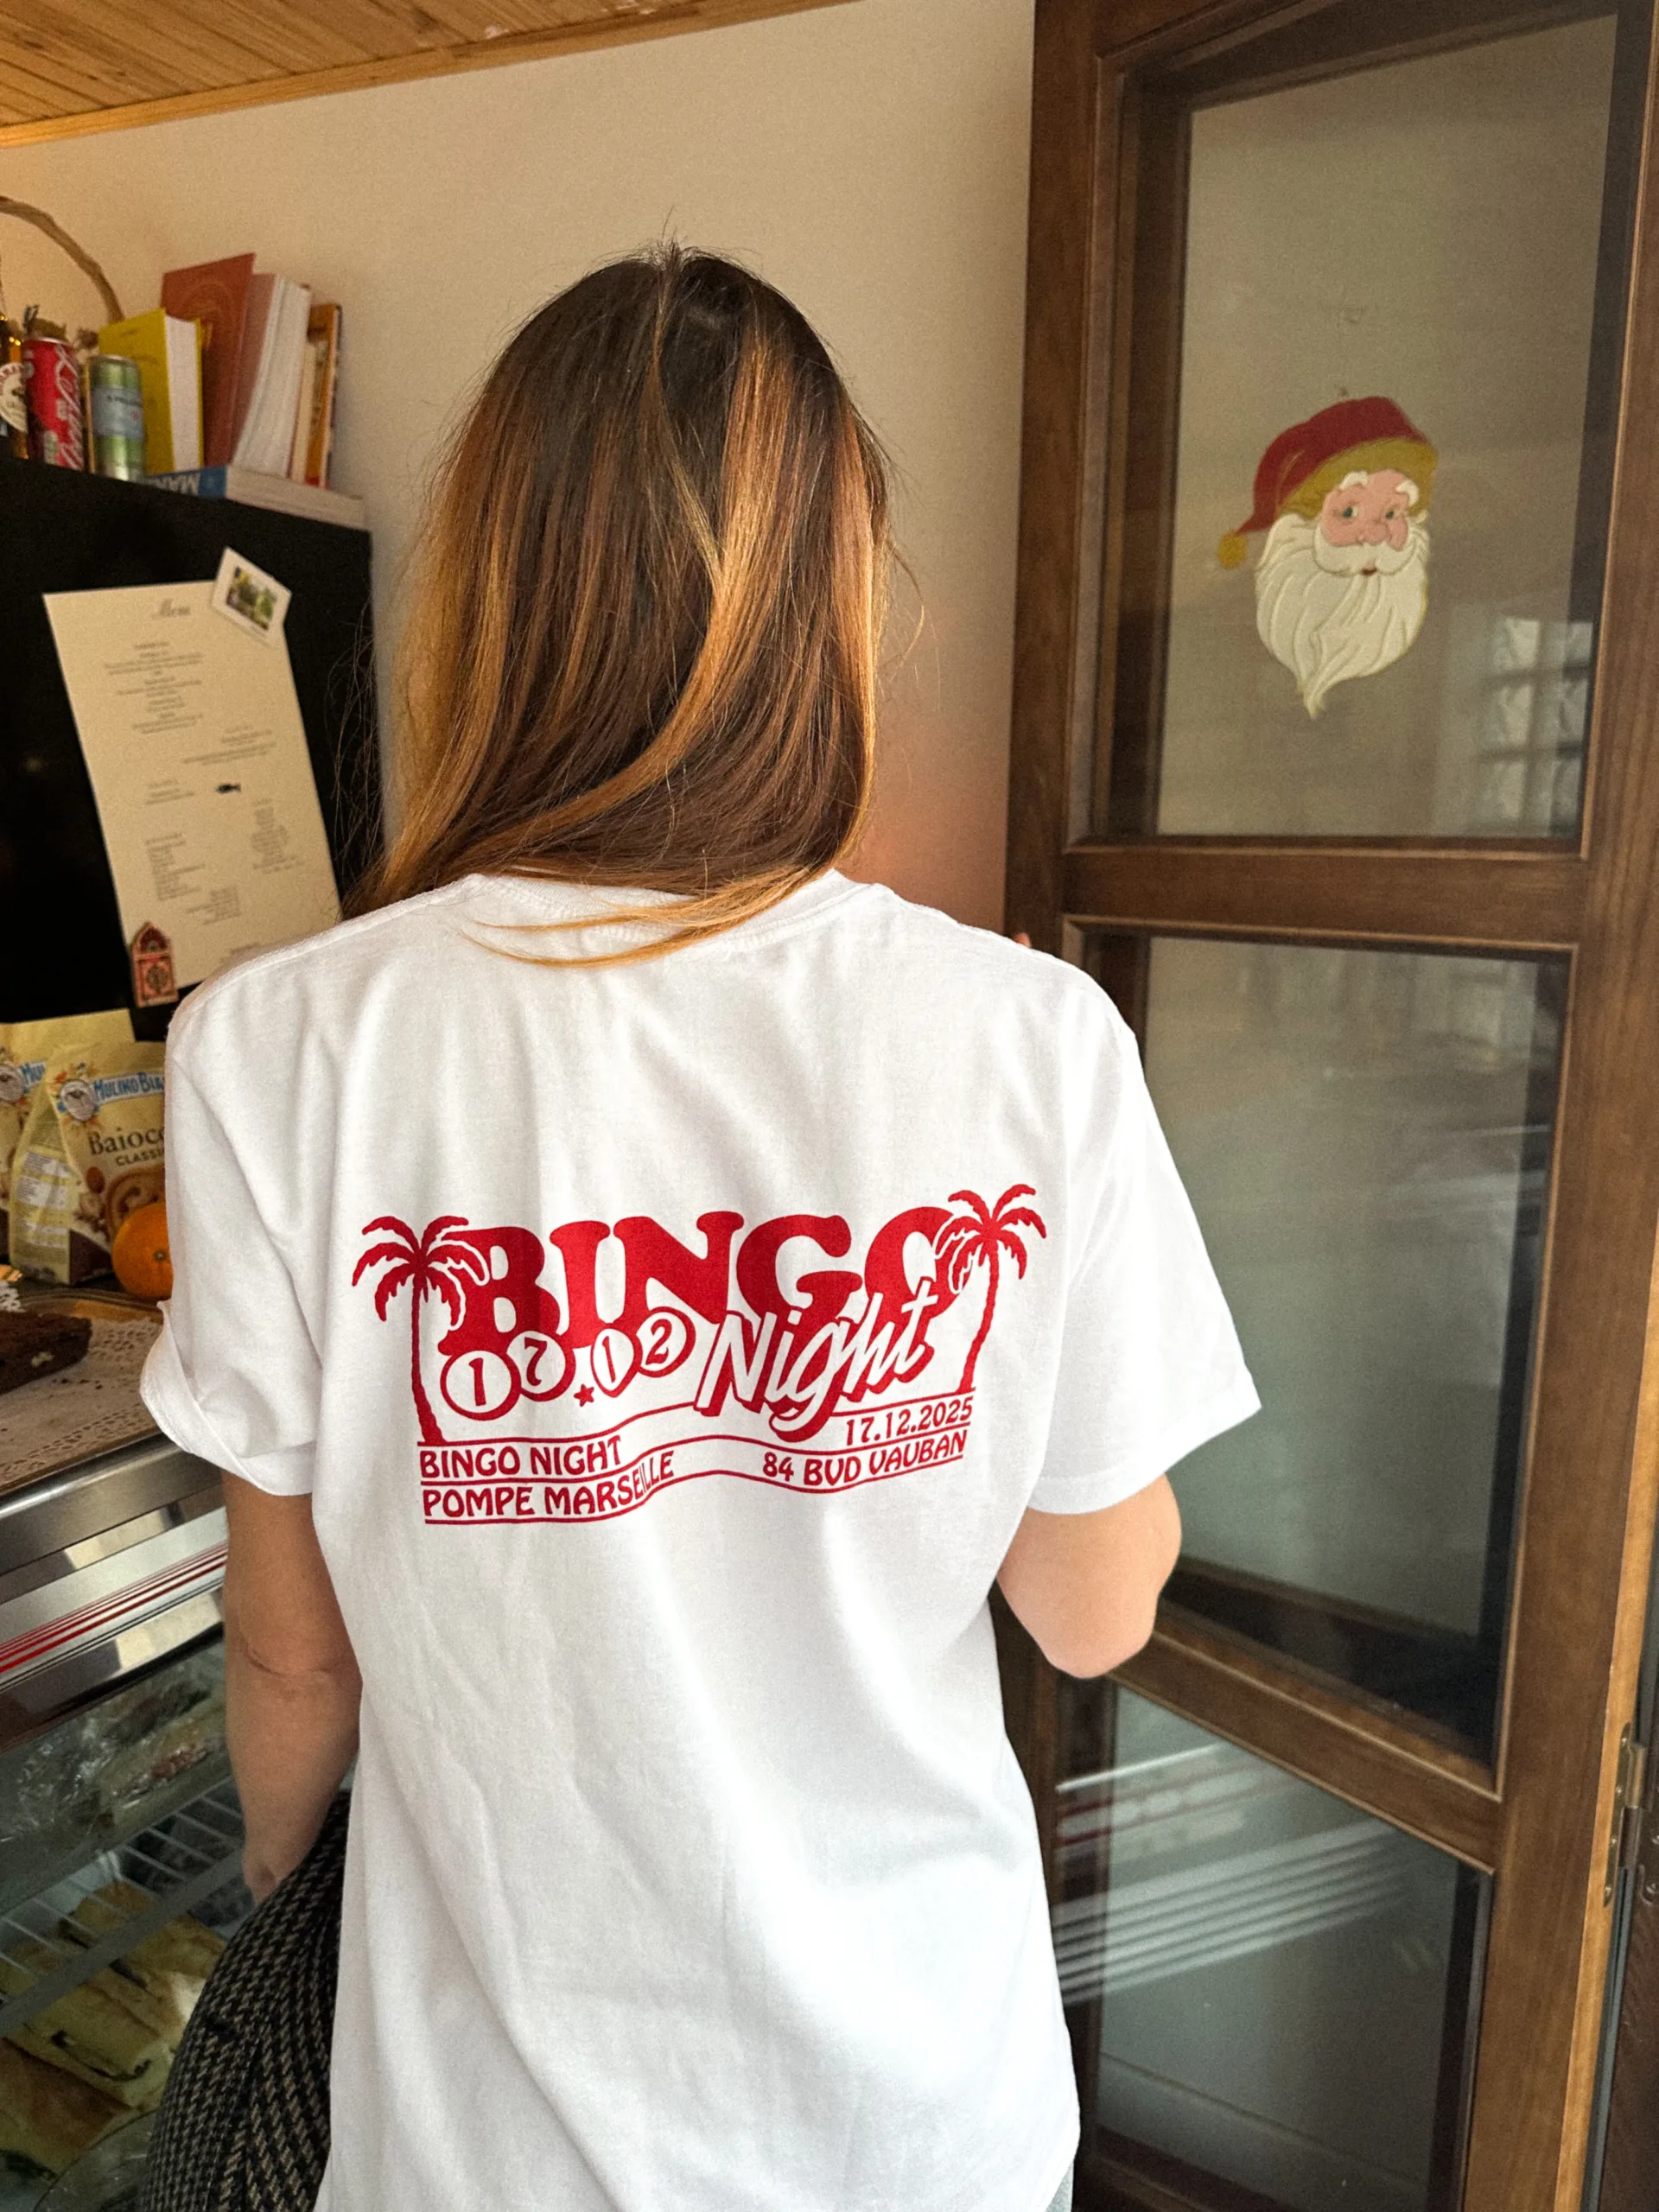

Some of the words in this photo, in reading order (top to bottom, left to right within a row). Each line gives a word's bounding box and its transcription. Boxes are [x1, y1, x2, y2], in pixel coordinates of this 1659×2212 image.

[115, 1147, 164, 1166] CLASSI
[437, 1206, 969, 1357] BINGO
[693, 1276, 938, 1442] Night
[846, 1395, 974, 1446] 17.12.2025
[419, 1446, 521, 1478] BINGO
[530, 1434, 621, 1476] NIGHT
[762, 1452, 794, 1482] 84
[868, 1429, 968, 1475] VAUBAN
[423, 1486, 535, 1517] POMPE
[543, 1450, 675, 1516] MARSEILLE
